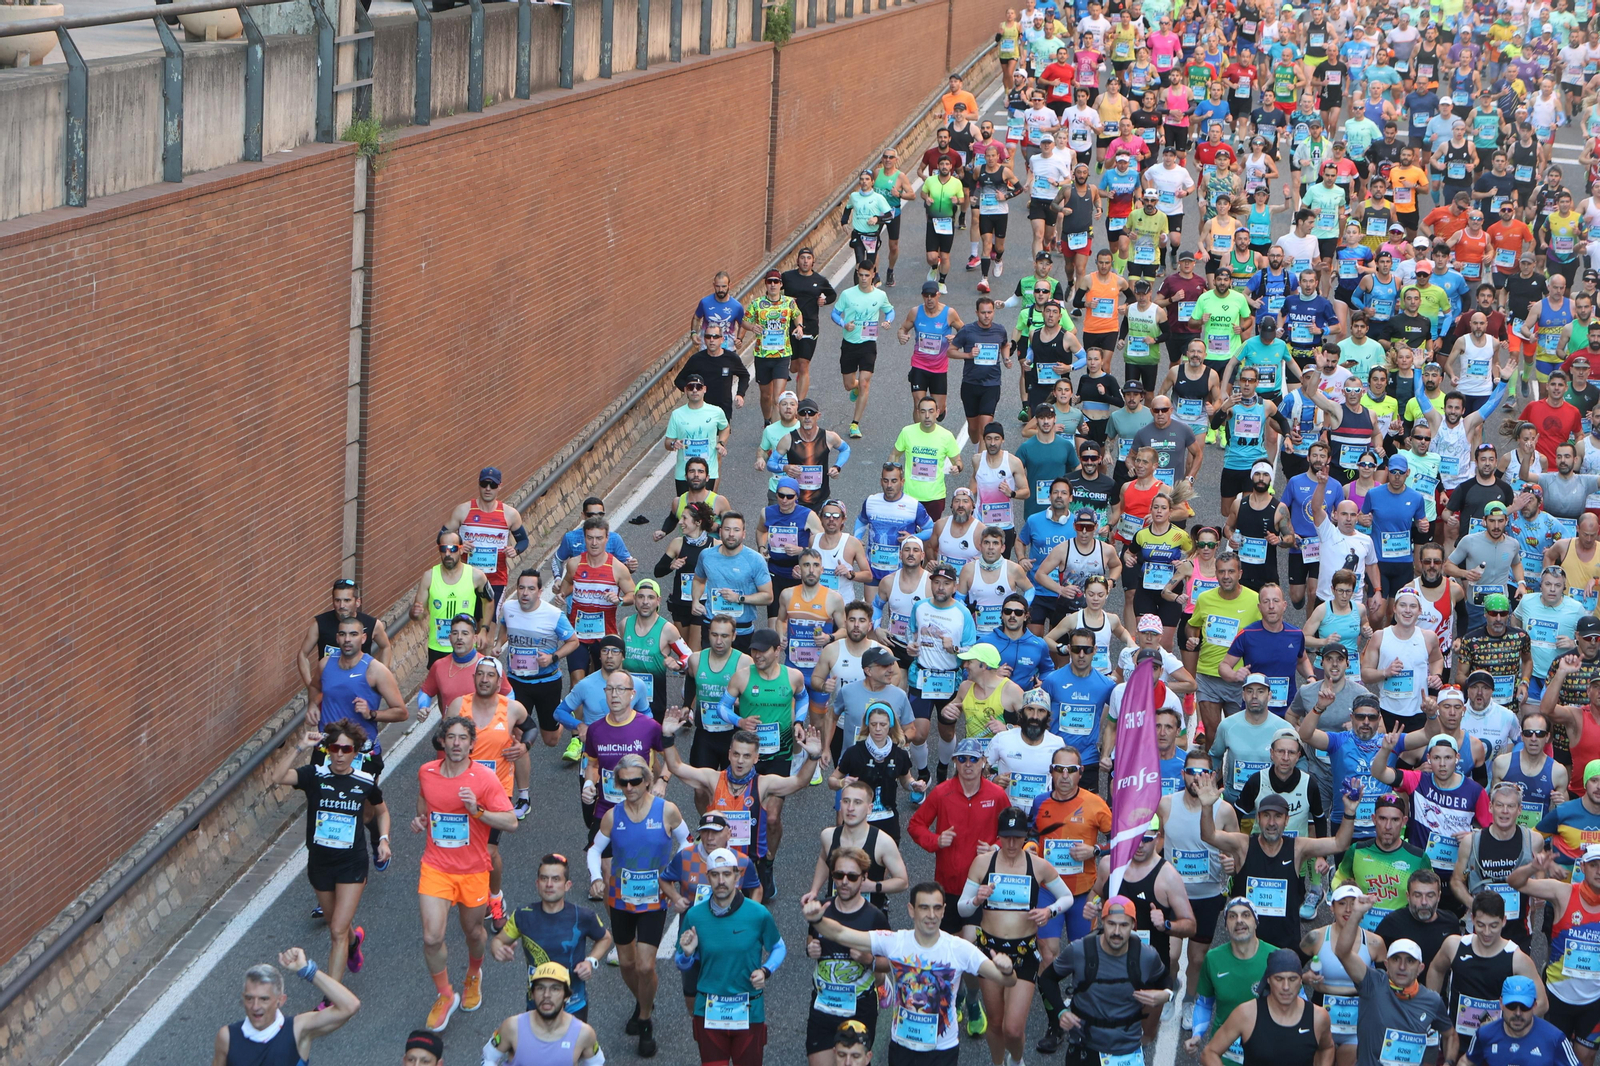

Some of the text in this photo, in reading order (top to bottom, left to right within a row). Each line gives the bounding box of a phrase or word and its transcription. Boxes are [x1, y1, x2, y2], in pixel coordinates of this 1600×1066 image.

[1125, 514, 1141, 524] ZURICH
[1052, 535, 1066, 544] GO
[1217, 618, 1236, 626] ZURICH
[1124, 712, 1135, 729] 3H
[597, 743, 633, 752] WellChild
[1117, 766, 1159, 792] renfe
[1426, 789, 1468, 809] XANDER
[330, 815, 351, 824] ZURICH
[442, 815, 464, 823] ZURICH
[1366, 874, 1400, 888] RUN
[1259, 892, 1273, 900] 5310
[1473, 1001, 1497, 1009] ZURICH
[909, 1015, 932, 1023] ZURICH
[1401, 1035, 1423, 1043] ZURICH
